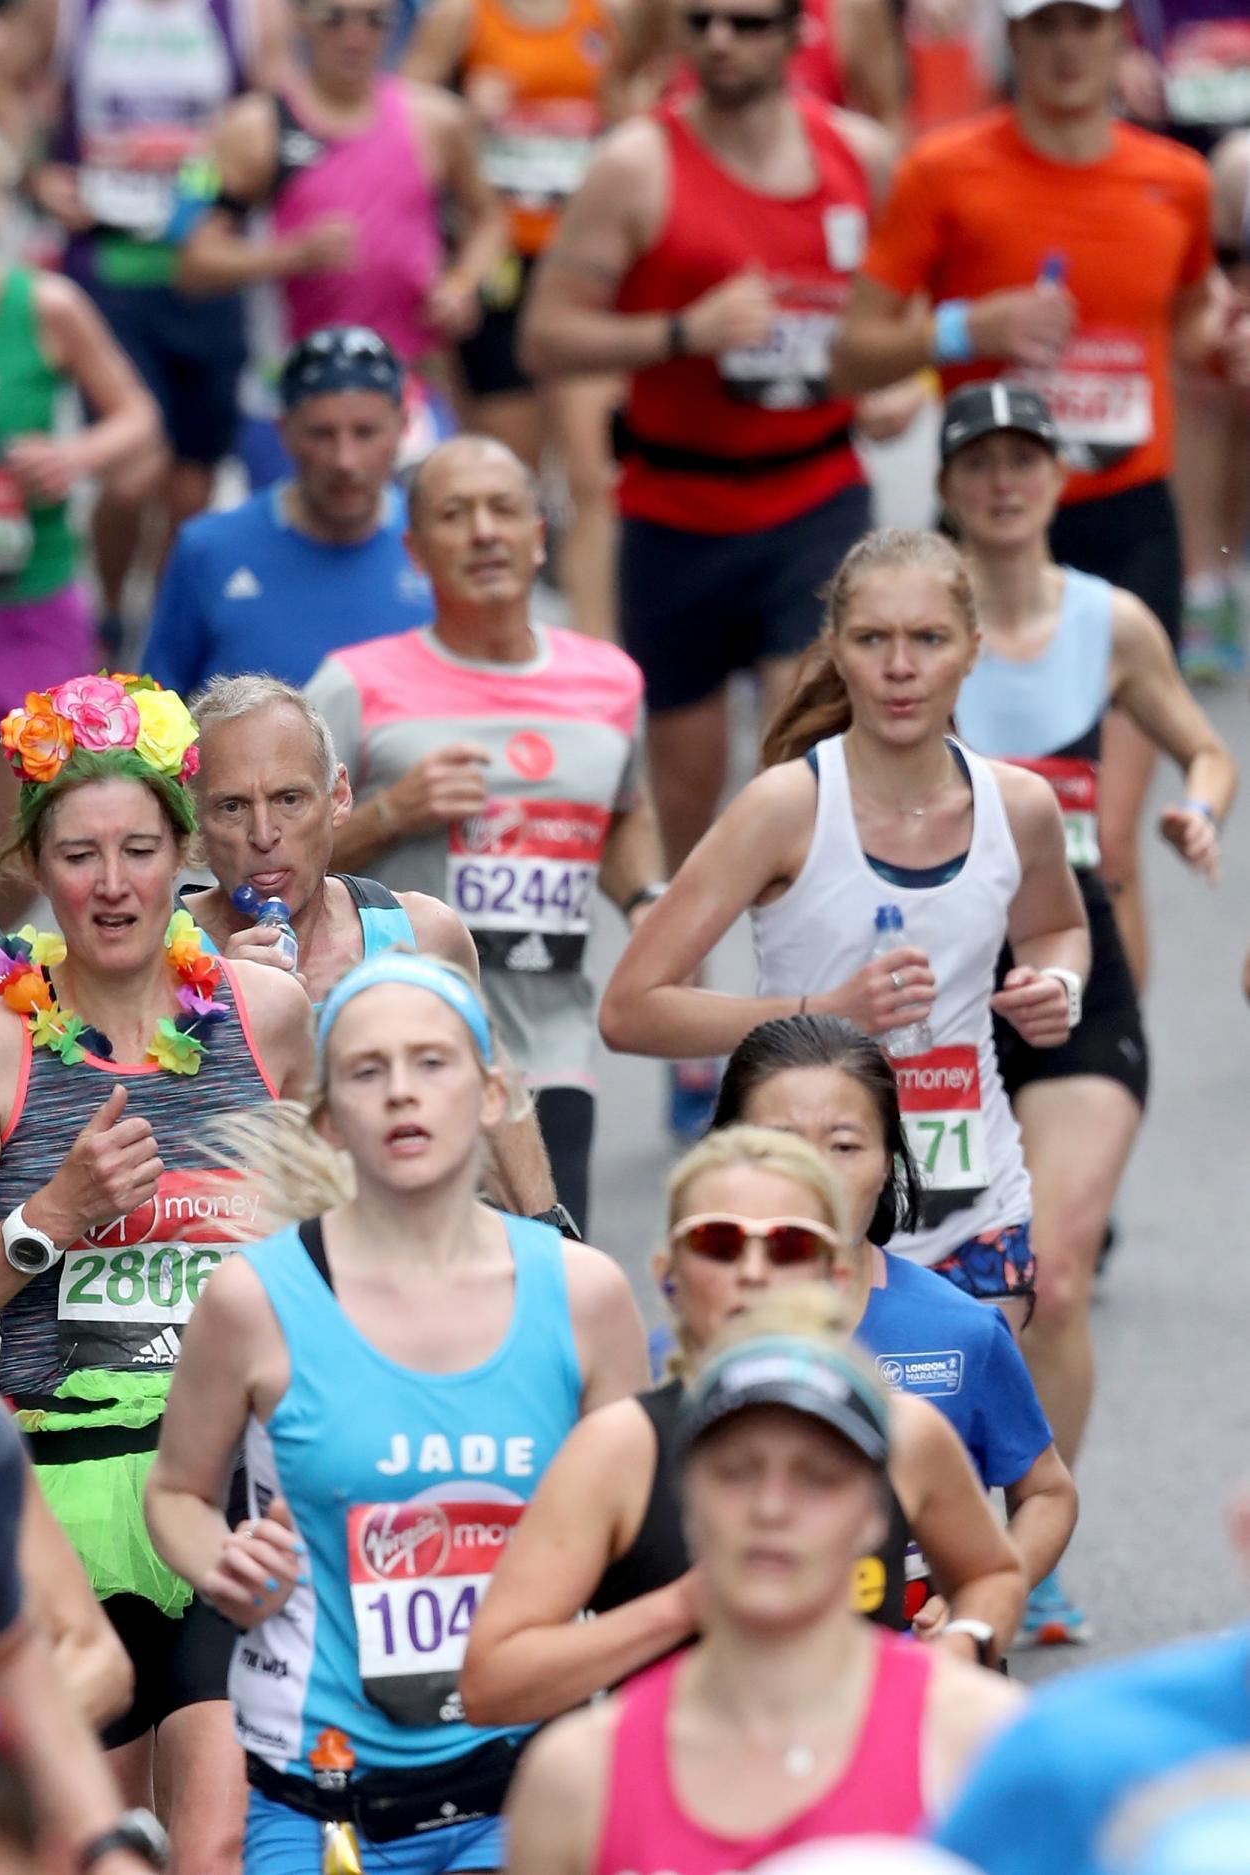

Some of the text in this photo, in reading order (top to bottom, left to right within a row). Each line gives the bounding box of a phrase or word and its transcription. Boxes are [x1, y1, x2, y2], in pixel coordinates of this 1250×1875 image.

[896, 1066, 975, 1093] money
[896, 1118, 972, 1173] 71
[164, 1194, 260, 1223] money
[905, 1361, 947, 1373] LONDON
[905, 1370, 959, 1381] MARATHON
[374, 1433, 535, 1476] JADE
